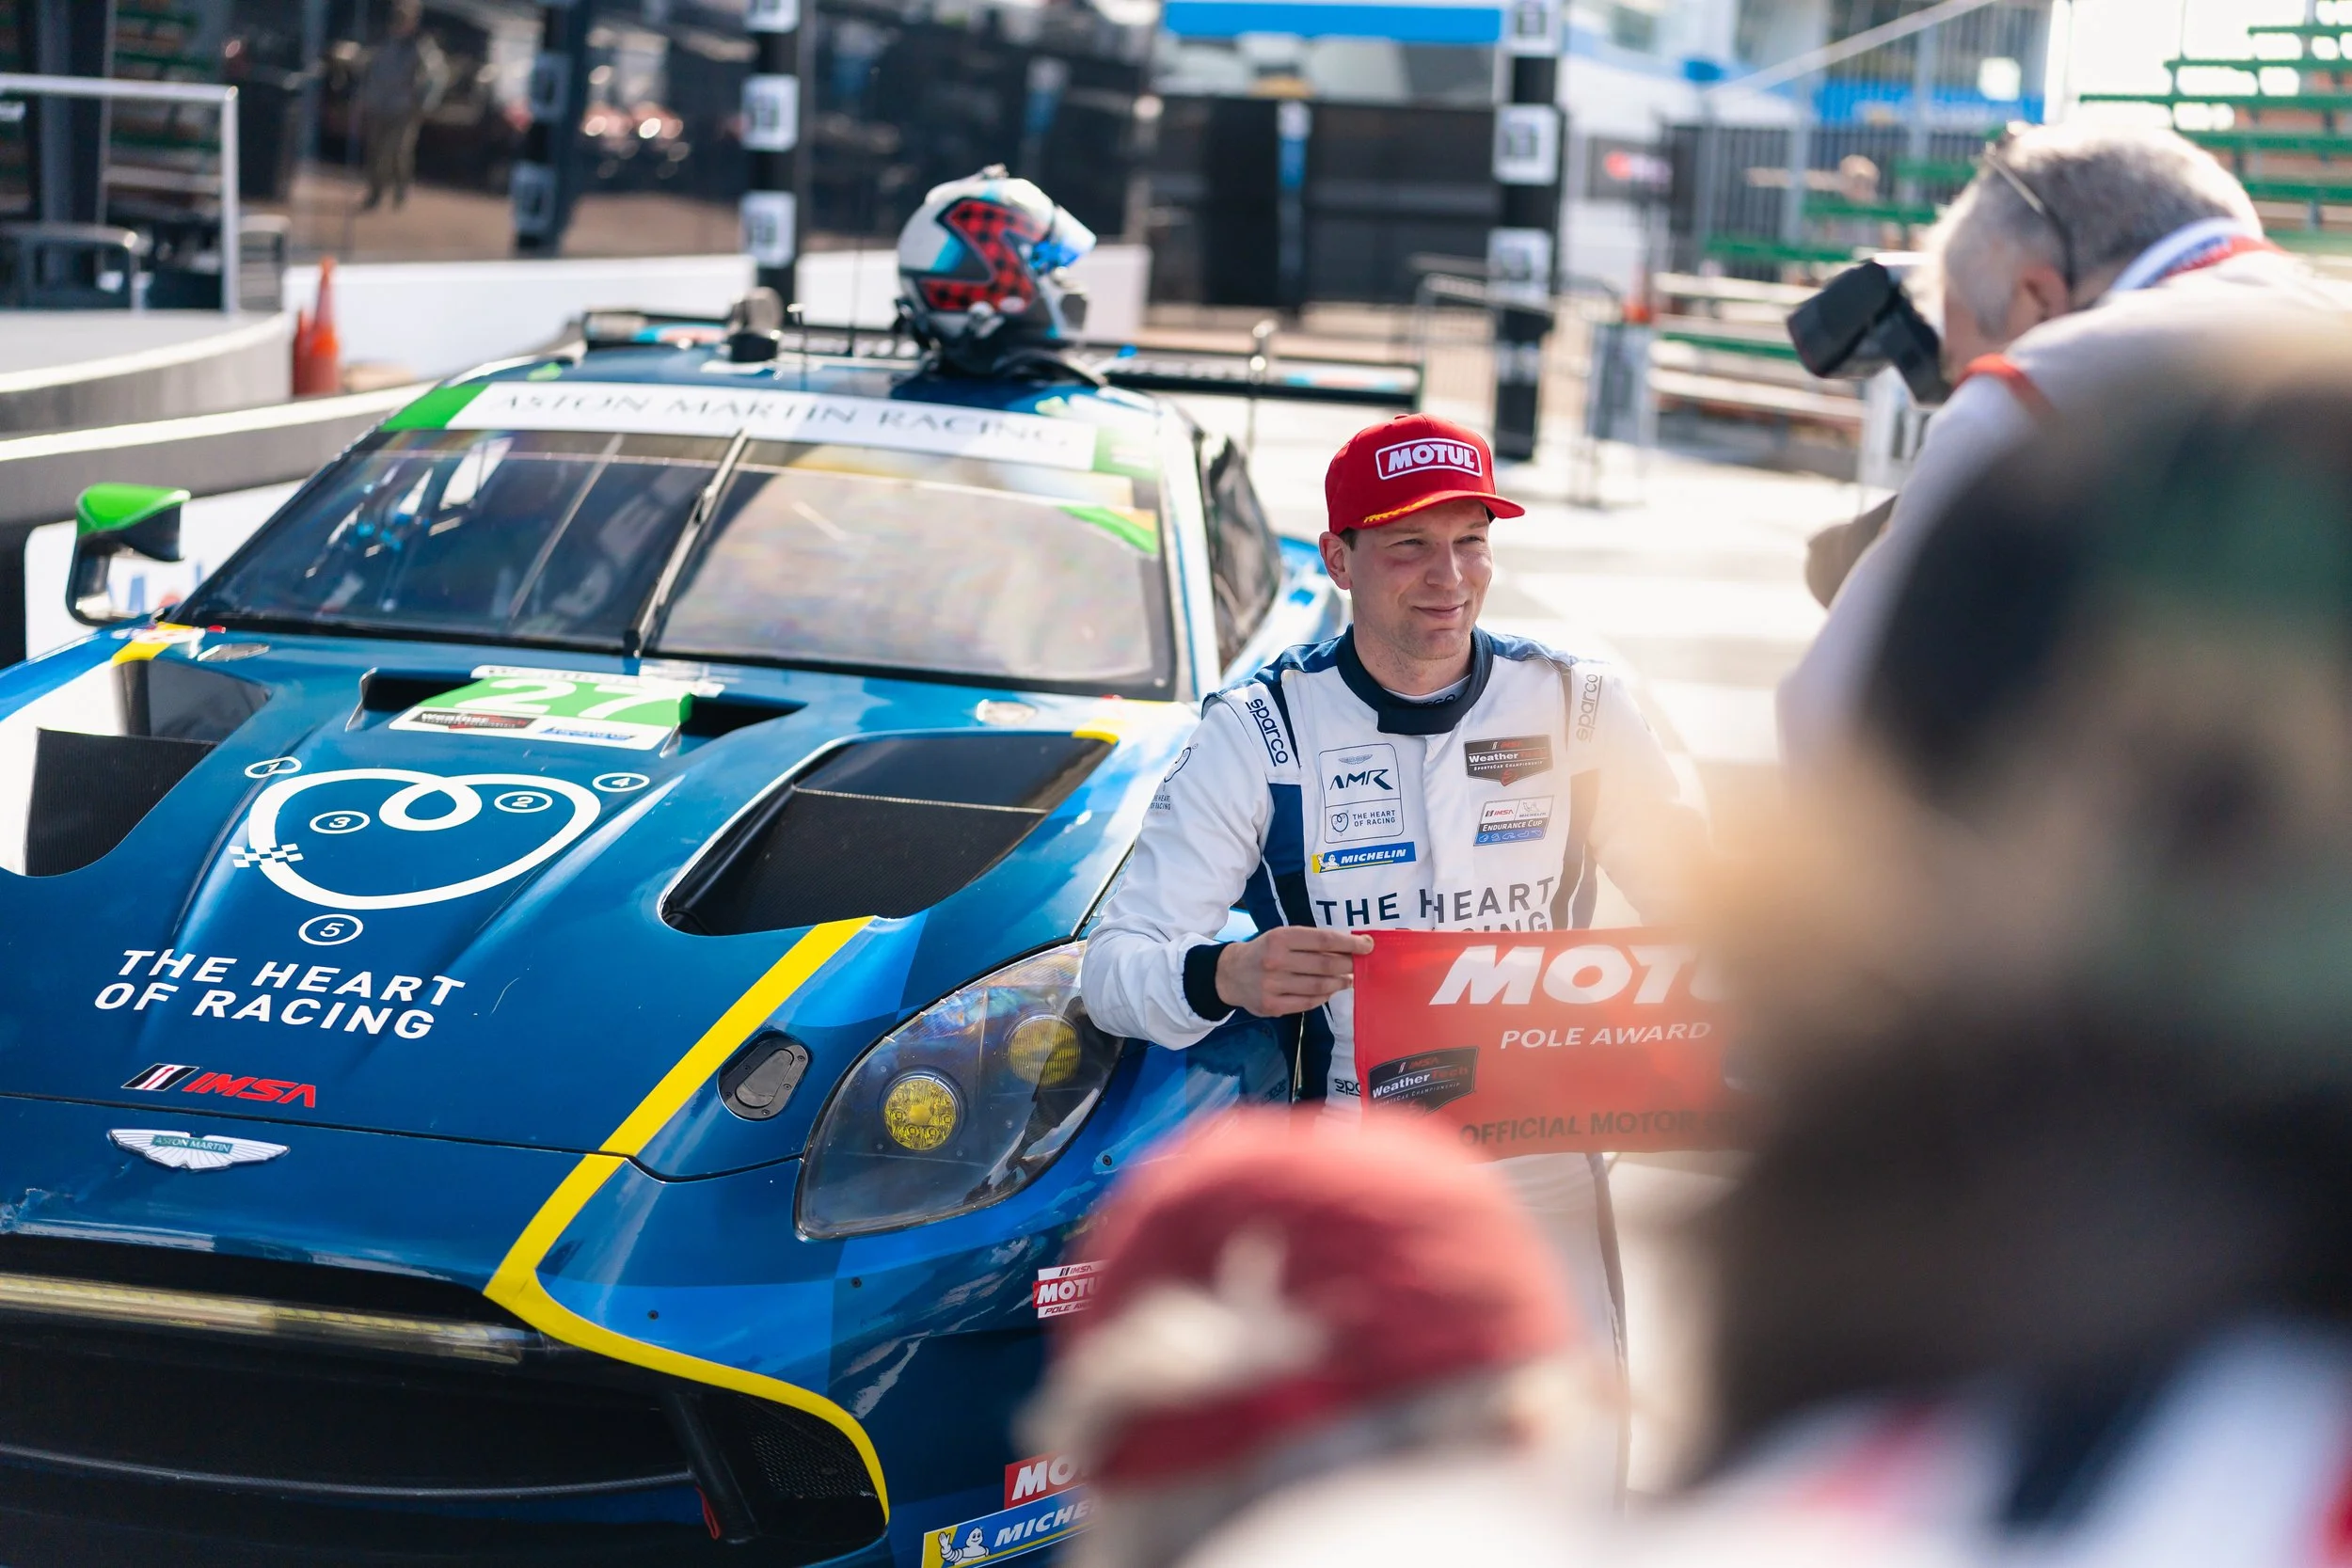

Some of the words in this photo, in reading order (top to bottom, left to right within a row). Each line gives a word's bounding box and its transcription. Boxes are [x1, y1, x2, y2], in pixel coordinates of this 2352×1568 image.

[666, 398, 857, 424] MARTIN
[1388, 444, 1475, 472] MOTUL
[454, 678, 682, 721] 27
[1576, 673, 1599, 742] sparco
[1248, 698, 1289, 765] sparco
[1329, 768, 1393, 791] AMR
[1353, 812, 1367, 820] THE
[1370, 810, 1396, 818] HEART
[1367, 816, 1396, 825] RACING
[1341, 848, 1406, 863] MICHELIN
[1316, 893, 1400, 927] THE
[1419, 877, 1554, 924] HEART
[319, 922, 344, 937] 5
[119, 949, 237, 983] THE
[251, 961, 467, 1006] HEART
[94, 982, 180, 1011] OF
[192, 990, 435, 1039] RACING
[1500, 1027, 1585, 1050] POLE
[1590, 1022, 1712, 1046] AWARD
[182, 1072, 317, 1109] IMSA
[1462, 1116, 1582, 1146] OFFICIAL
[1590, 1110, 1695, 1135] MOTOR
[155, 1137, 188, 1148] ASTON
[189, 1141, 230, 1152] MARTIN
[1037, 1277, 1099, 1305] MOTU
[1045, 1305, 1072, 1315] POLE
[994, 1499, 1094, 1548] MICHE
